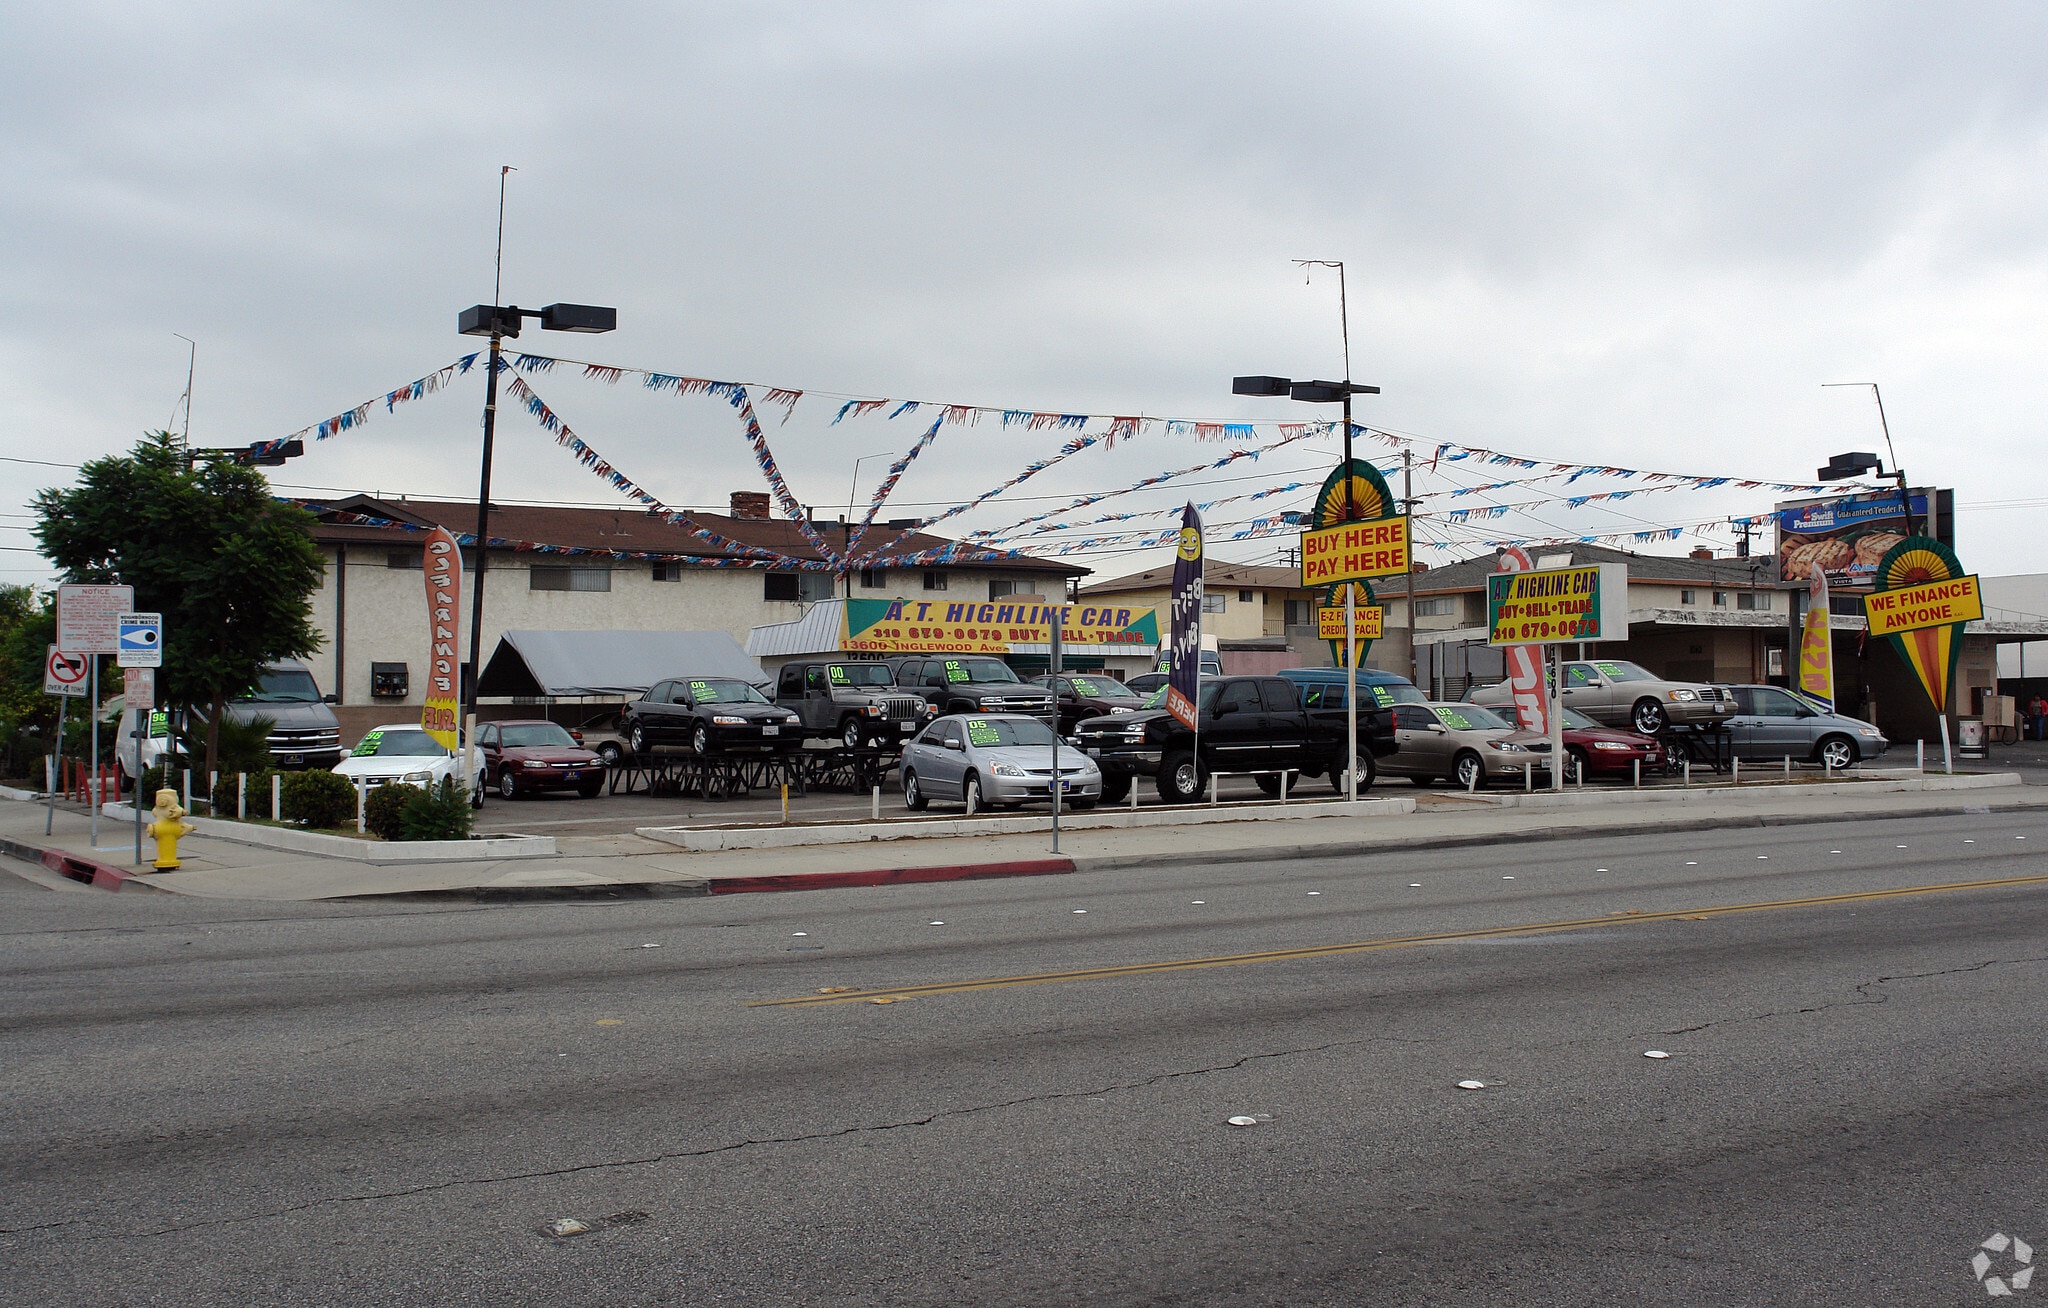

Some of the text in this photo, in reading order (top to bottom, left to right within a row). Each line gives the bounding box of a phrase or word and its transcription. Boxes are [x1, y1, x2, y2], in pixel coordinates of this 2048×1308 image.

[1810, 511, 1834, 521] Swift
[1837, 507, 1873, 519] Guaranteed
[1874, 505, 1897, 515] Tender
[1793, 519, 1834, 529] Premium
[1306, 524, 1403, 556] BUY HERE
[1306, 548, 1404, 579] PAY HERE
[1493, 571, 1597, 601] A.T. HIGHLINE CAR
[1871, 581, 1972, 612] WE FINANCE
[884, 601, 1131, 627] A.T. HIGHLINE CAR
[1320, 610, 1380, 622] E-Z FIANCE
[1885, 605, 1952, 629] ANYONE
[1354, 624, 1379, 635] FACIL
[1493, 627, 1516, 640] 310
[873, 628, 901, 638] 310
[1009, 629, 1040, 641] BUY
[1062, 630, 1087, 642] ELL
[1096, 631, 1144, 643] TRADE
[842, 640, 887, 650] 13600
[895, 642, 972, 651] INGLEWOOD
[945, 661, 960, 670] 02
[830, 666, 844, 678] 00
[62, 684, 69, 693] 4
[690, 681, 706, 689] 00
[1435, 707, 1453, 715] 03
[152, 713, 166, 722] 98
[968, 721, 987, 729] 05
[365, 731, 384, 740] 98
